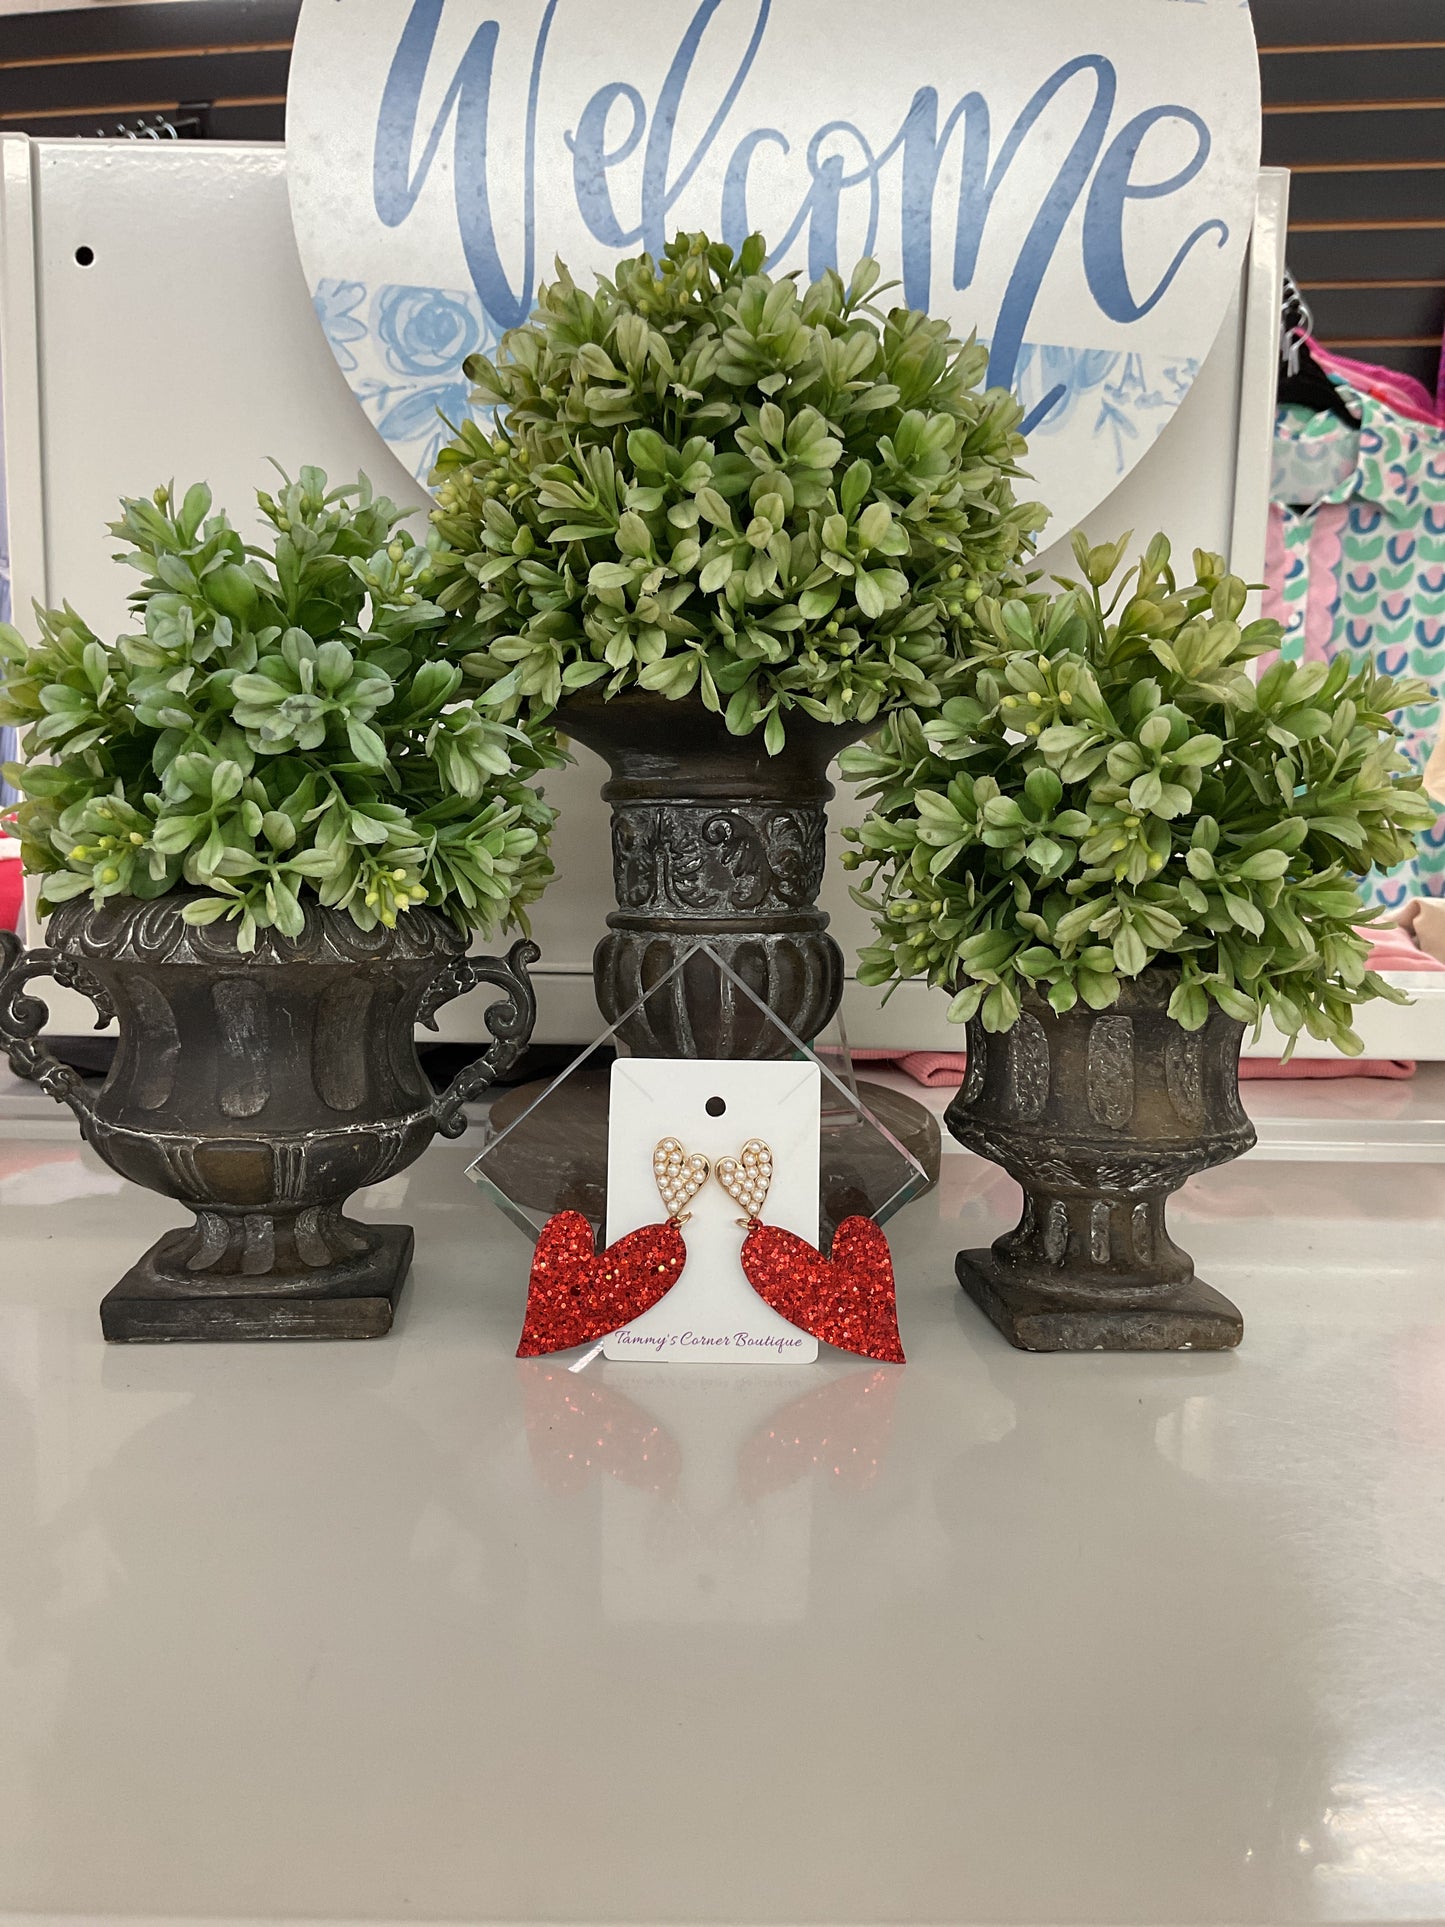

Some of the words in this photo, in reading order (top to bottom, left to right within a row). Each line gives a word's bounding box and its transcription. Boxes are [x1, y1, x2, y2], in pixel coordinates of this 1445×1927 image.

[374, 0, 1229, 436] Welcome
[615, 1330, 678, 1351] Tammy's
[680, 1331, 731, 1346] Corner
[734, 1332, 803, 1353] Boutique
